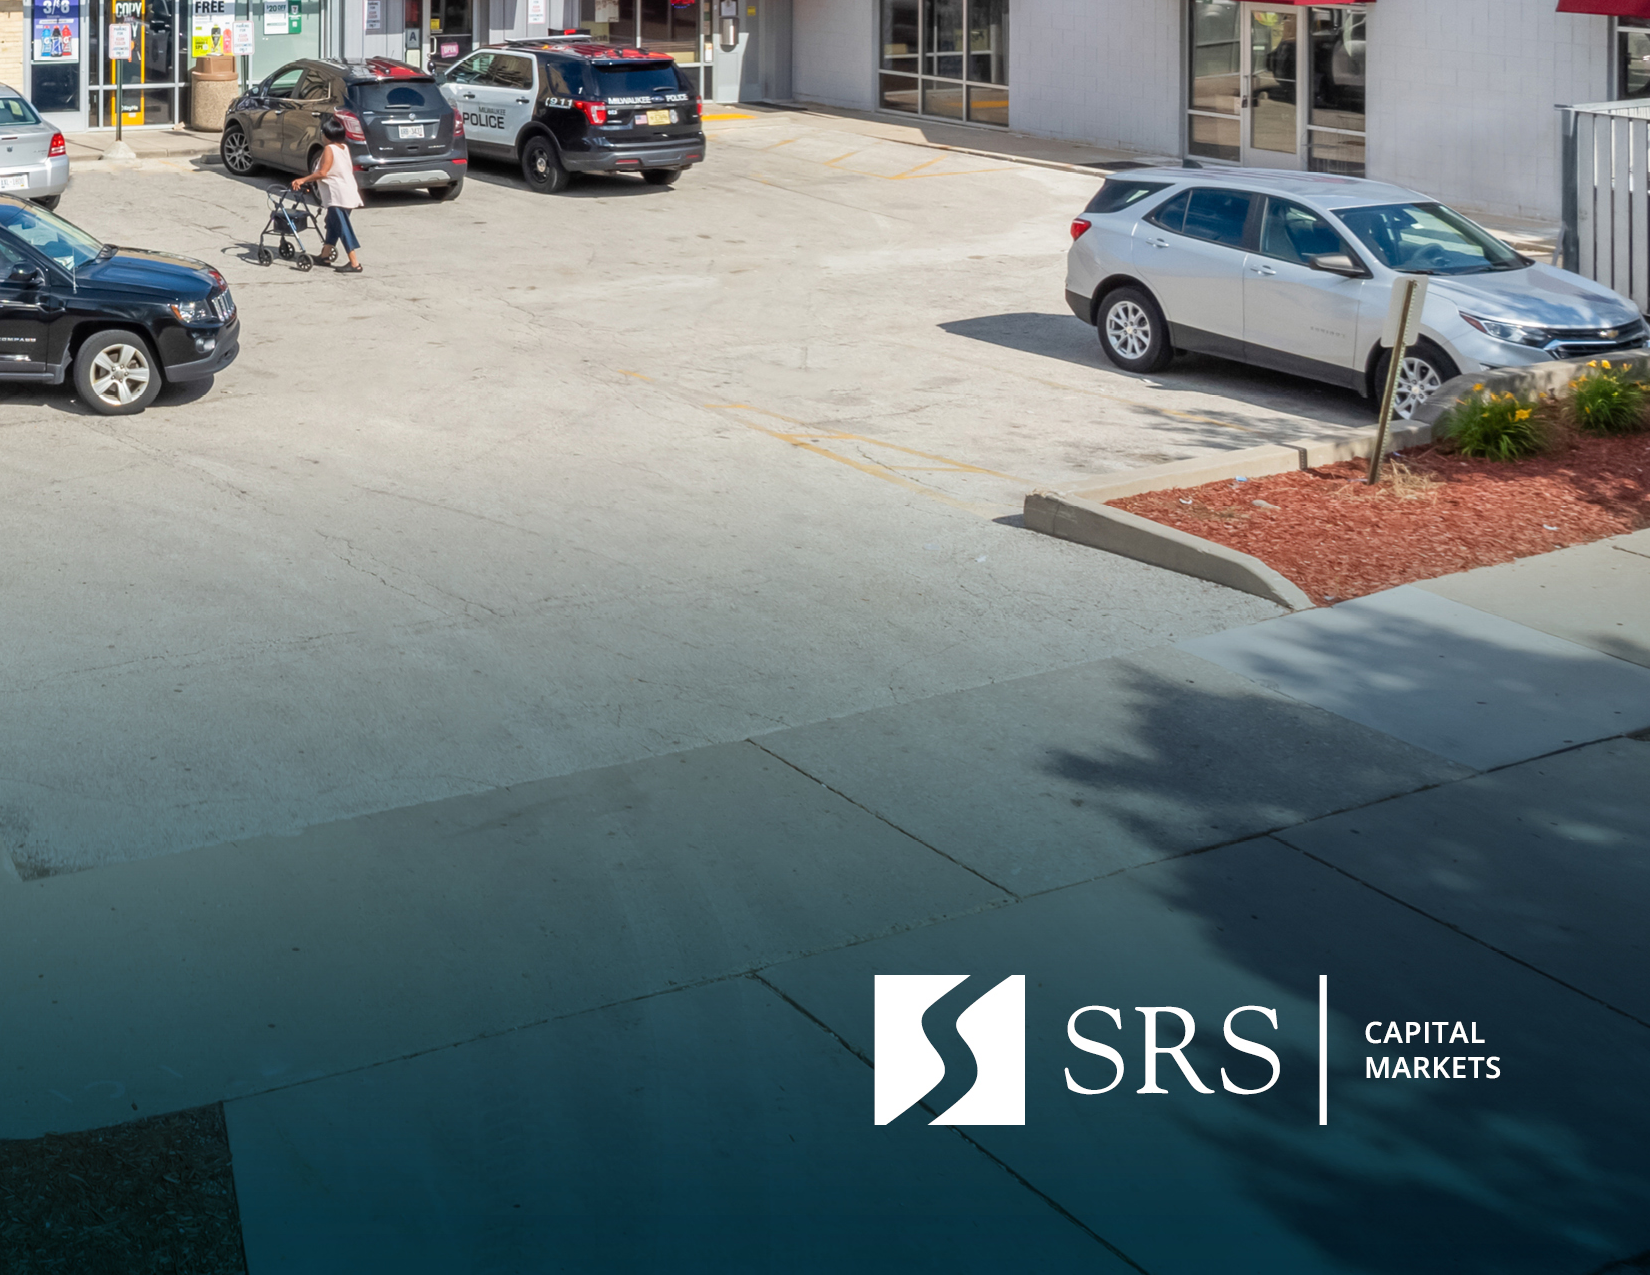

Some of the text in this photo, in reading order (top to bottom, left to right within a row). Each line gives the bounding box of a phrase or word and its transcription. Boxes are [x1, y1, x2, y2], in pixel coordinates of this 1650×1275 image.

[115, 2, 142, 18] COPY
[195, 1, 225, 14] FREE
[409, 32, 417, 41] A
[608, 94, 689, 105] MILWAUKEE POLICE
[478, 106, 506, 116] MILWAUKEE
[463, 112, 505, 129] POLICE
